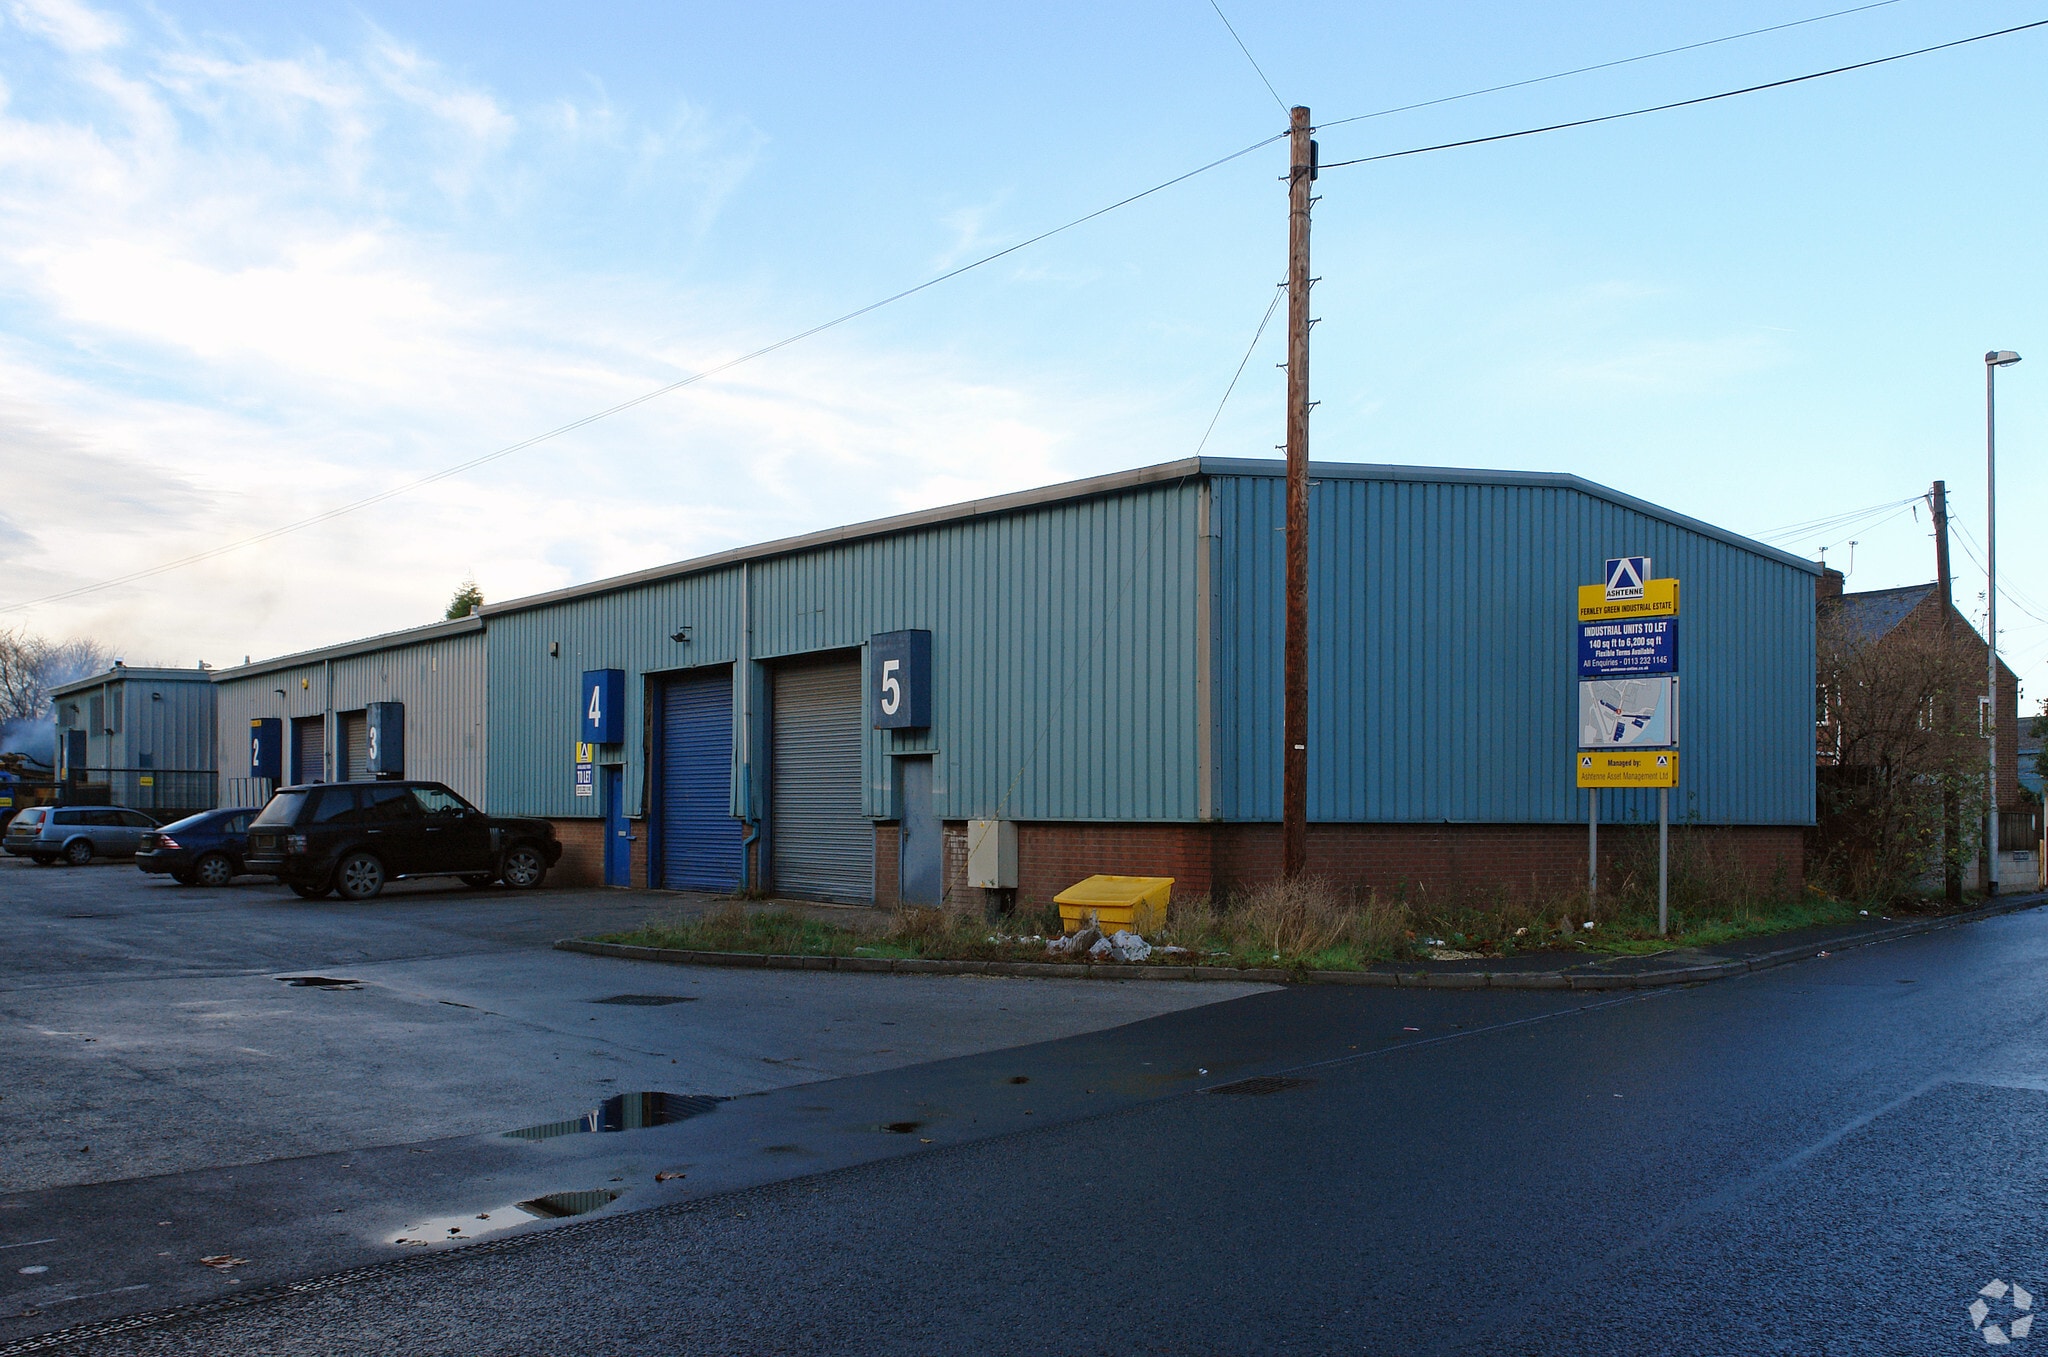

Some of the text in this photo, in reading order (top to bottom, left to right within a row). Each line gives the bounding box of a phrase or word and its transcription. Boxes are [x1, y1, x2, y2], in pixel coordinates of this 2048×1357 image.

[1606, 587, 1644, 597] ASHTENNE
[1580, 602, 1672, 616] FERNLEY GREEN INDUSTRIAL ESTATE
[1584, 622, 1667, 637] INDUSTRIAL UNITS TO LET
[1589, 639, 1601, 649] 140
[1602, 640, 1610, 649] sq
[1611, 638, 1618, 648] ft
[1618, 638, 1626, 648] to
[1646, 638, 1655, 648] sq
[1655, 636, 1662, 645] ft
[1583, 660, 1591, 668] All
[1592, 658, 1618, 668] Enquiries
[1623, 658, 1639, 666] 0113
[1639, 657, 1651, 665] 232
[881, 660, 900, 715] 5
[588, 685, 601, 728] 4
[369, 726, 378, 760] 3
[252, 738, 260, 767] 2
[1607, 759, 1642, 768] Managed by:
[577, 770, 592, 784] TO LET
[1581, 771, 1669, 782] Ashtenne Asset Management Ltd
